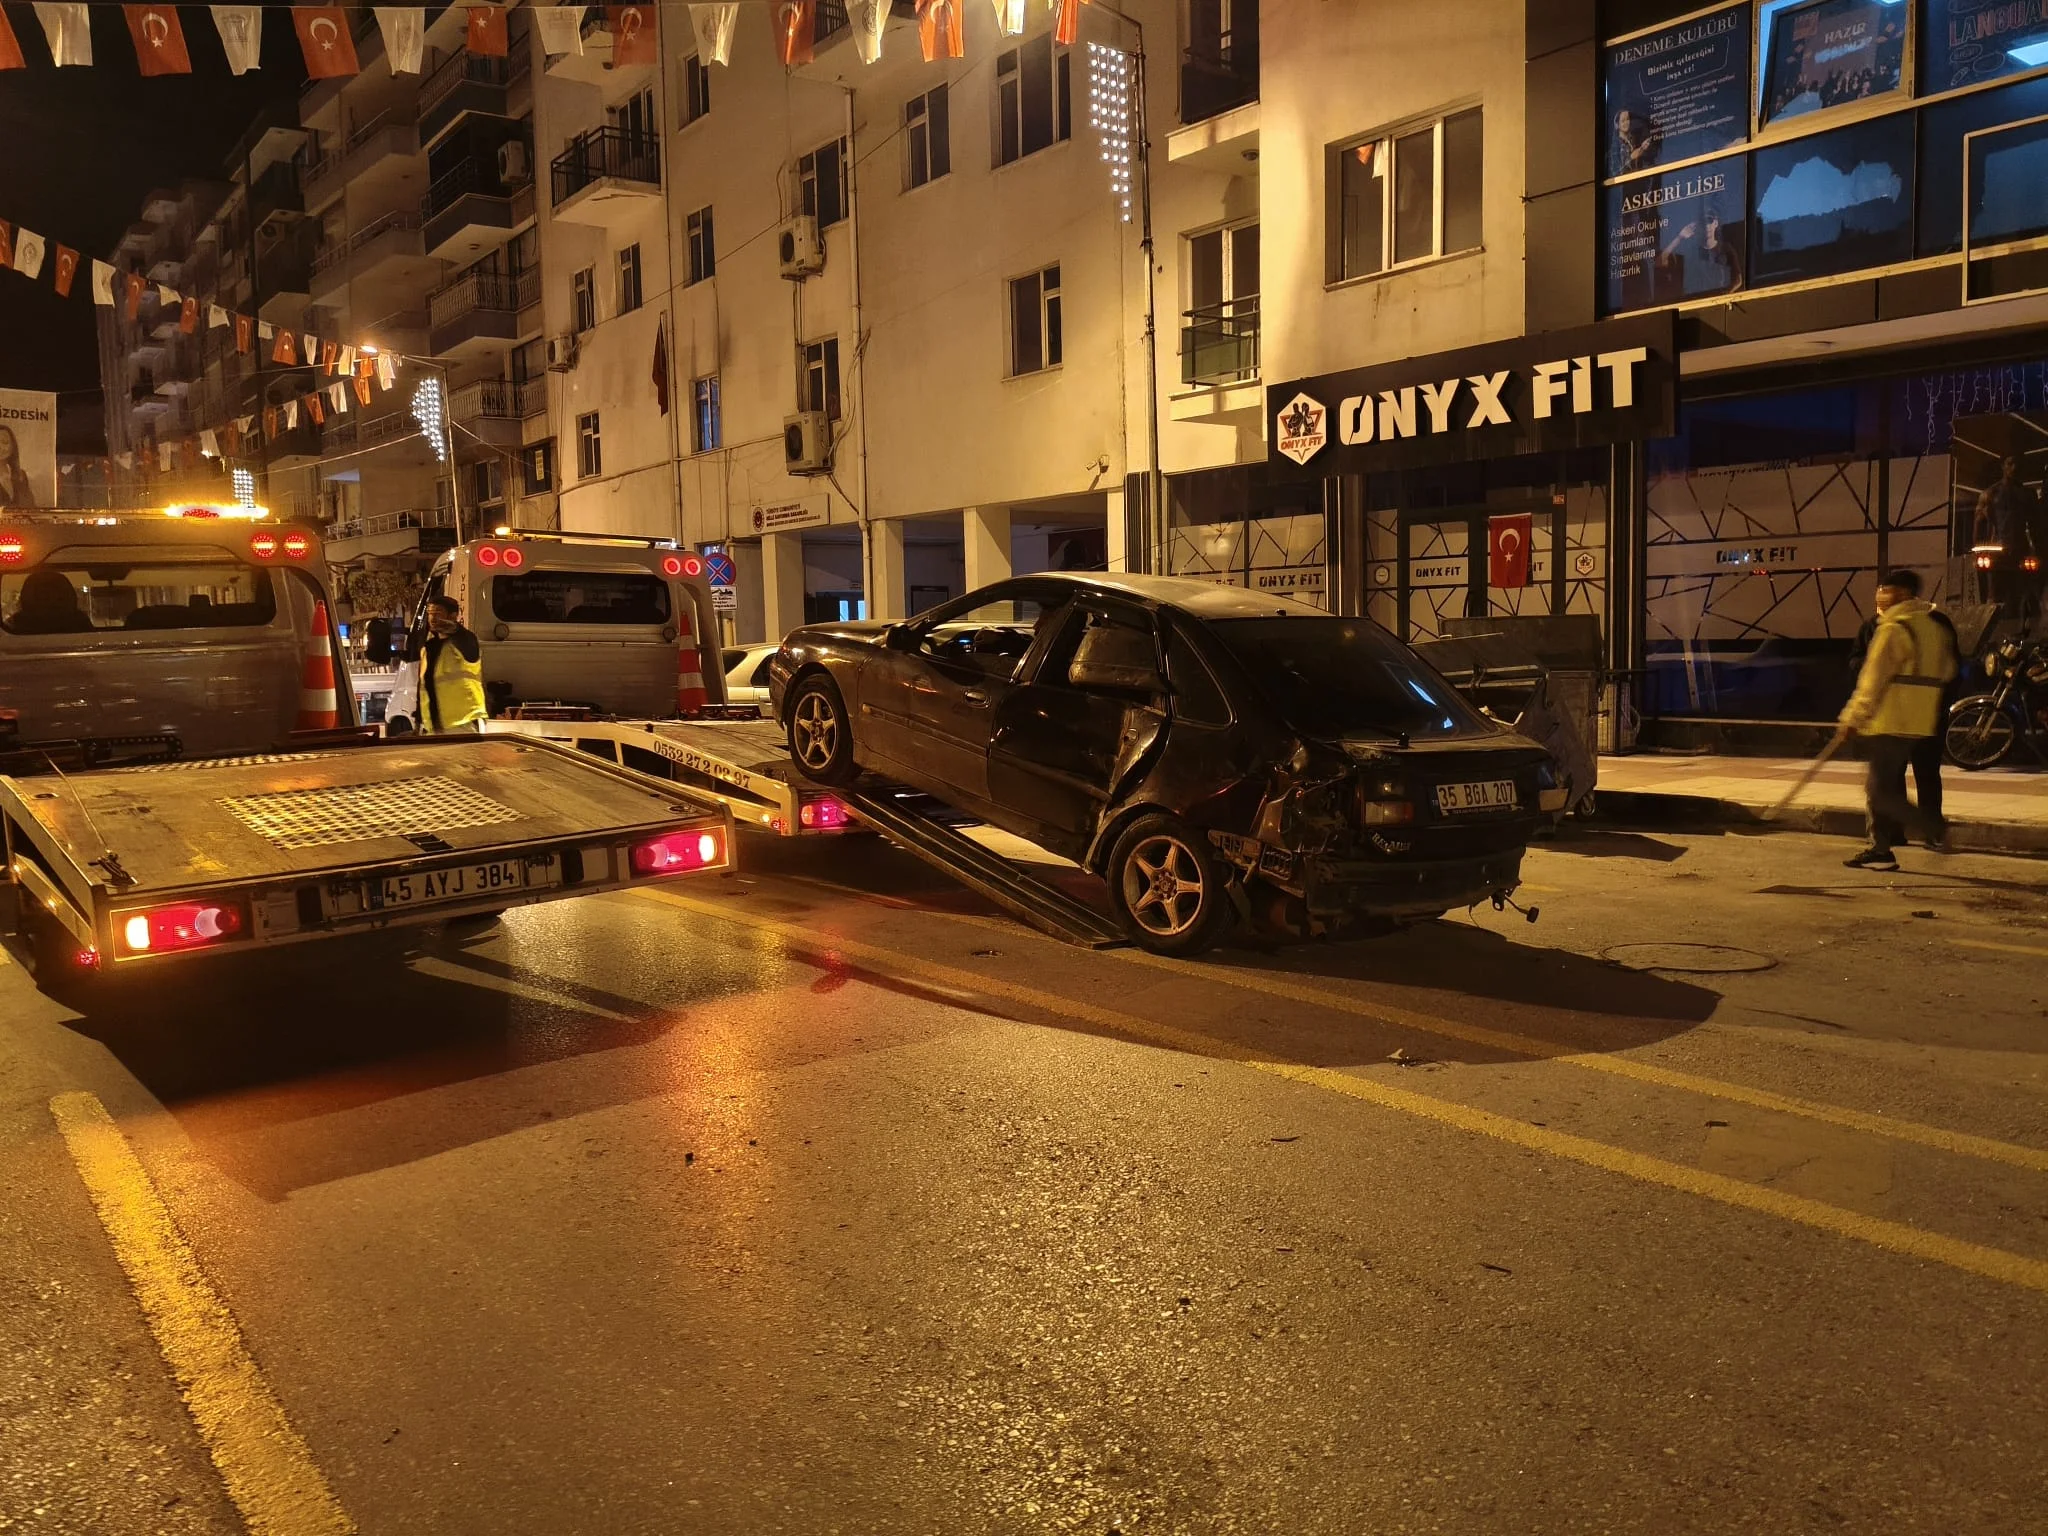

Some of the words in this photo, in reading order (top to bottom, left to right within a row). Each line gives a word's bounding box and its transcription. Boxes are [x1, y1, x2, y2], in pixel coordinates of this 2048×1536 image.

[1949, 0, 2048, 48] LANGUA
[1615, 35, 1674, 65] DENEME
[1678, 12, 1738, 44] KULÜBÜ
[1622, 181, 1681, 212] ASKERİ
[1687, 175, 1726, 196] LİSE
[1611, 225, 1636, 239] Askeri
[1638, 219, 1657, 233] Okul
[1659, 218, 1669, 227] ve
[1611, 235, 1655, 253] Kurumların
[1611, 248, 1656, 266] Sınavlarına
[1611, 265, 1641, 280] Hazırlık
[1340, 370, 1512, 446] ONYX
[1281, 438, 1307, 450] ONYX
[1259, 574, 1296, 588] ONYX
[1416, 567, 1443, 578] ONYX
[653, 740, 684, 763] 0532
[1438, 785, 1458, 808] 35
[1464, 783, 1489, 806] BGA
[1493, 782, 1513, 804] 207
[384, 878, 412, 903] 45
[424, 870, 464, 898] AYJ
[475, 863, 514, 889] 384
